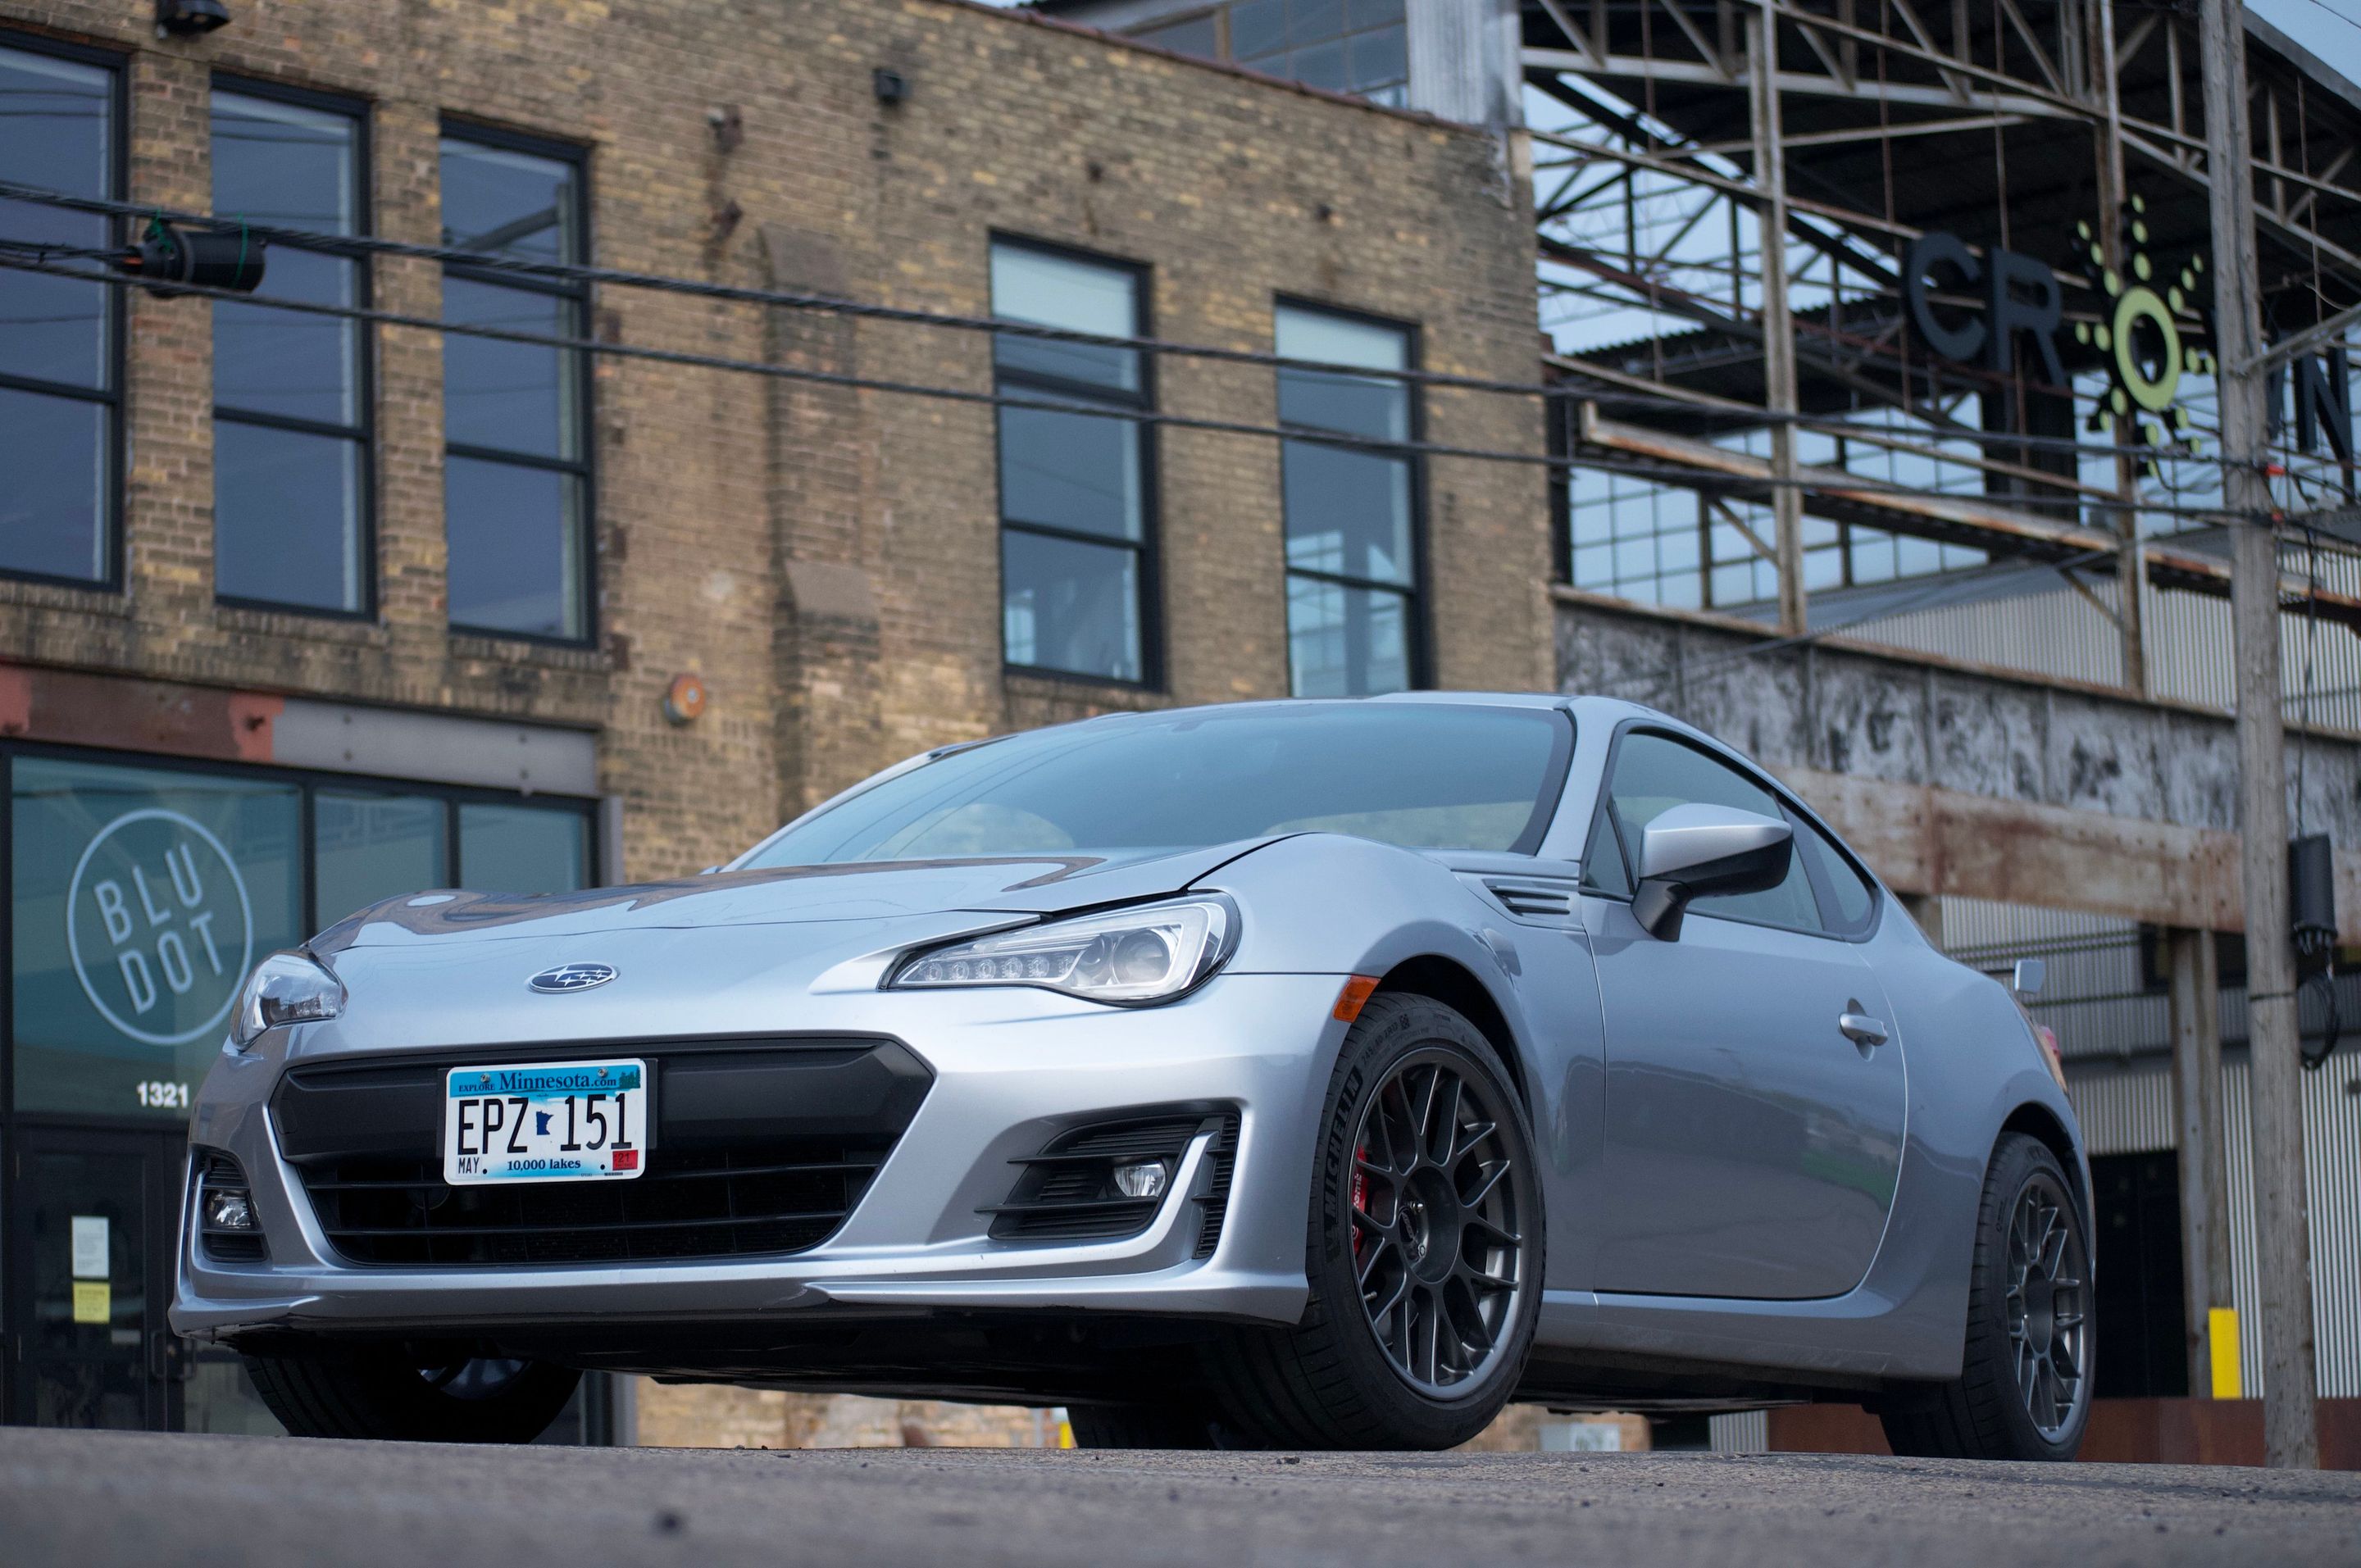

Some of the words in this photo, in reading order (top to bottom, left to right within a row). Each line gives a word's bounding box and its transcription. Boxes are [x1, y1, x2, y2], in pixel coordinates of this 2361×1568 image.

[93, 842, 203, 947] BLU
[118, 911, 223, 1016] DOT
[136, 1080, 189, 1108] 1321
[458, 1083, 495, 1093] EXPLORE
[498, 1069, 616, 1091] Minnesota.com
[457, 1097, 529, 1156] EPZ
[560, 1093, 632, 1152] 151
[617, 1152, 630, 1163] 21
[1324, 1070, 1362, 1219] MICHELIN
[457, 1157, 480, 1175] MAY
[507, 1159, 546, 1172] 10,000
[549, 1158, 581, 1170] lakes
